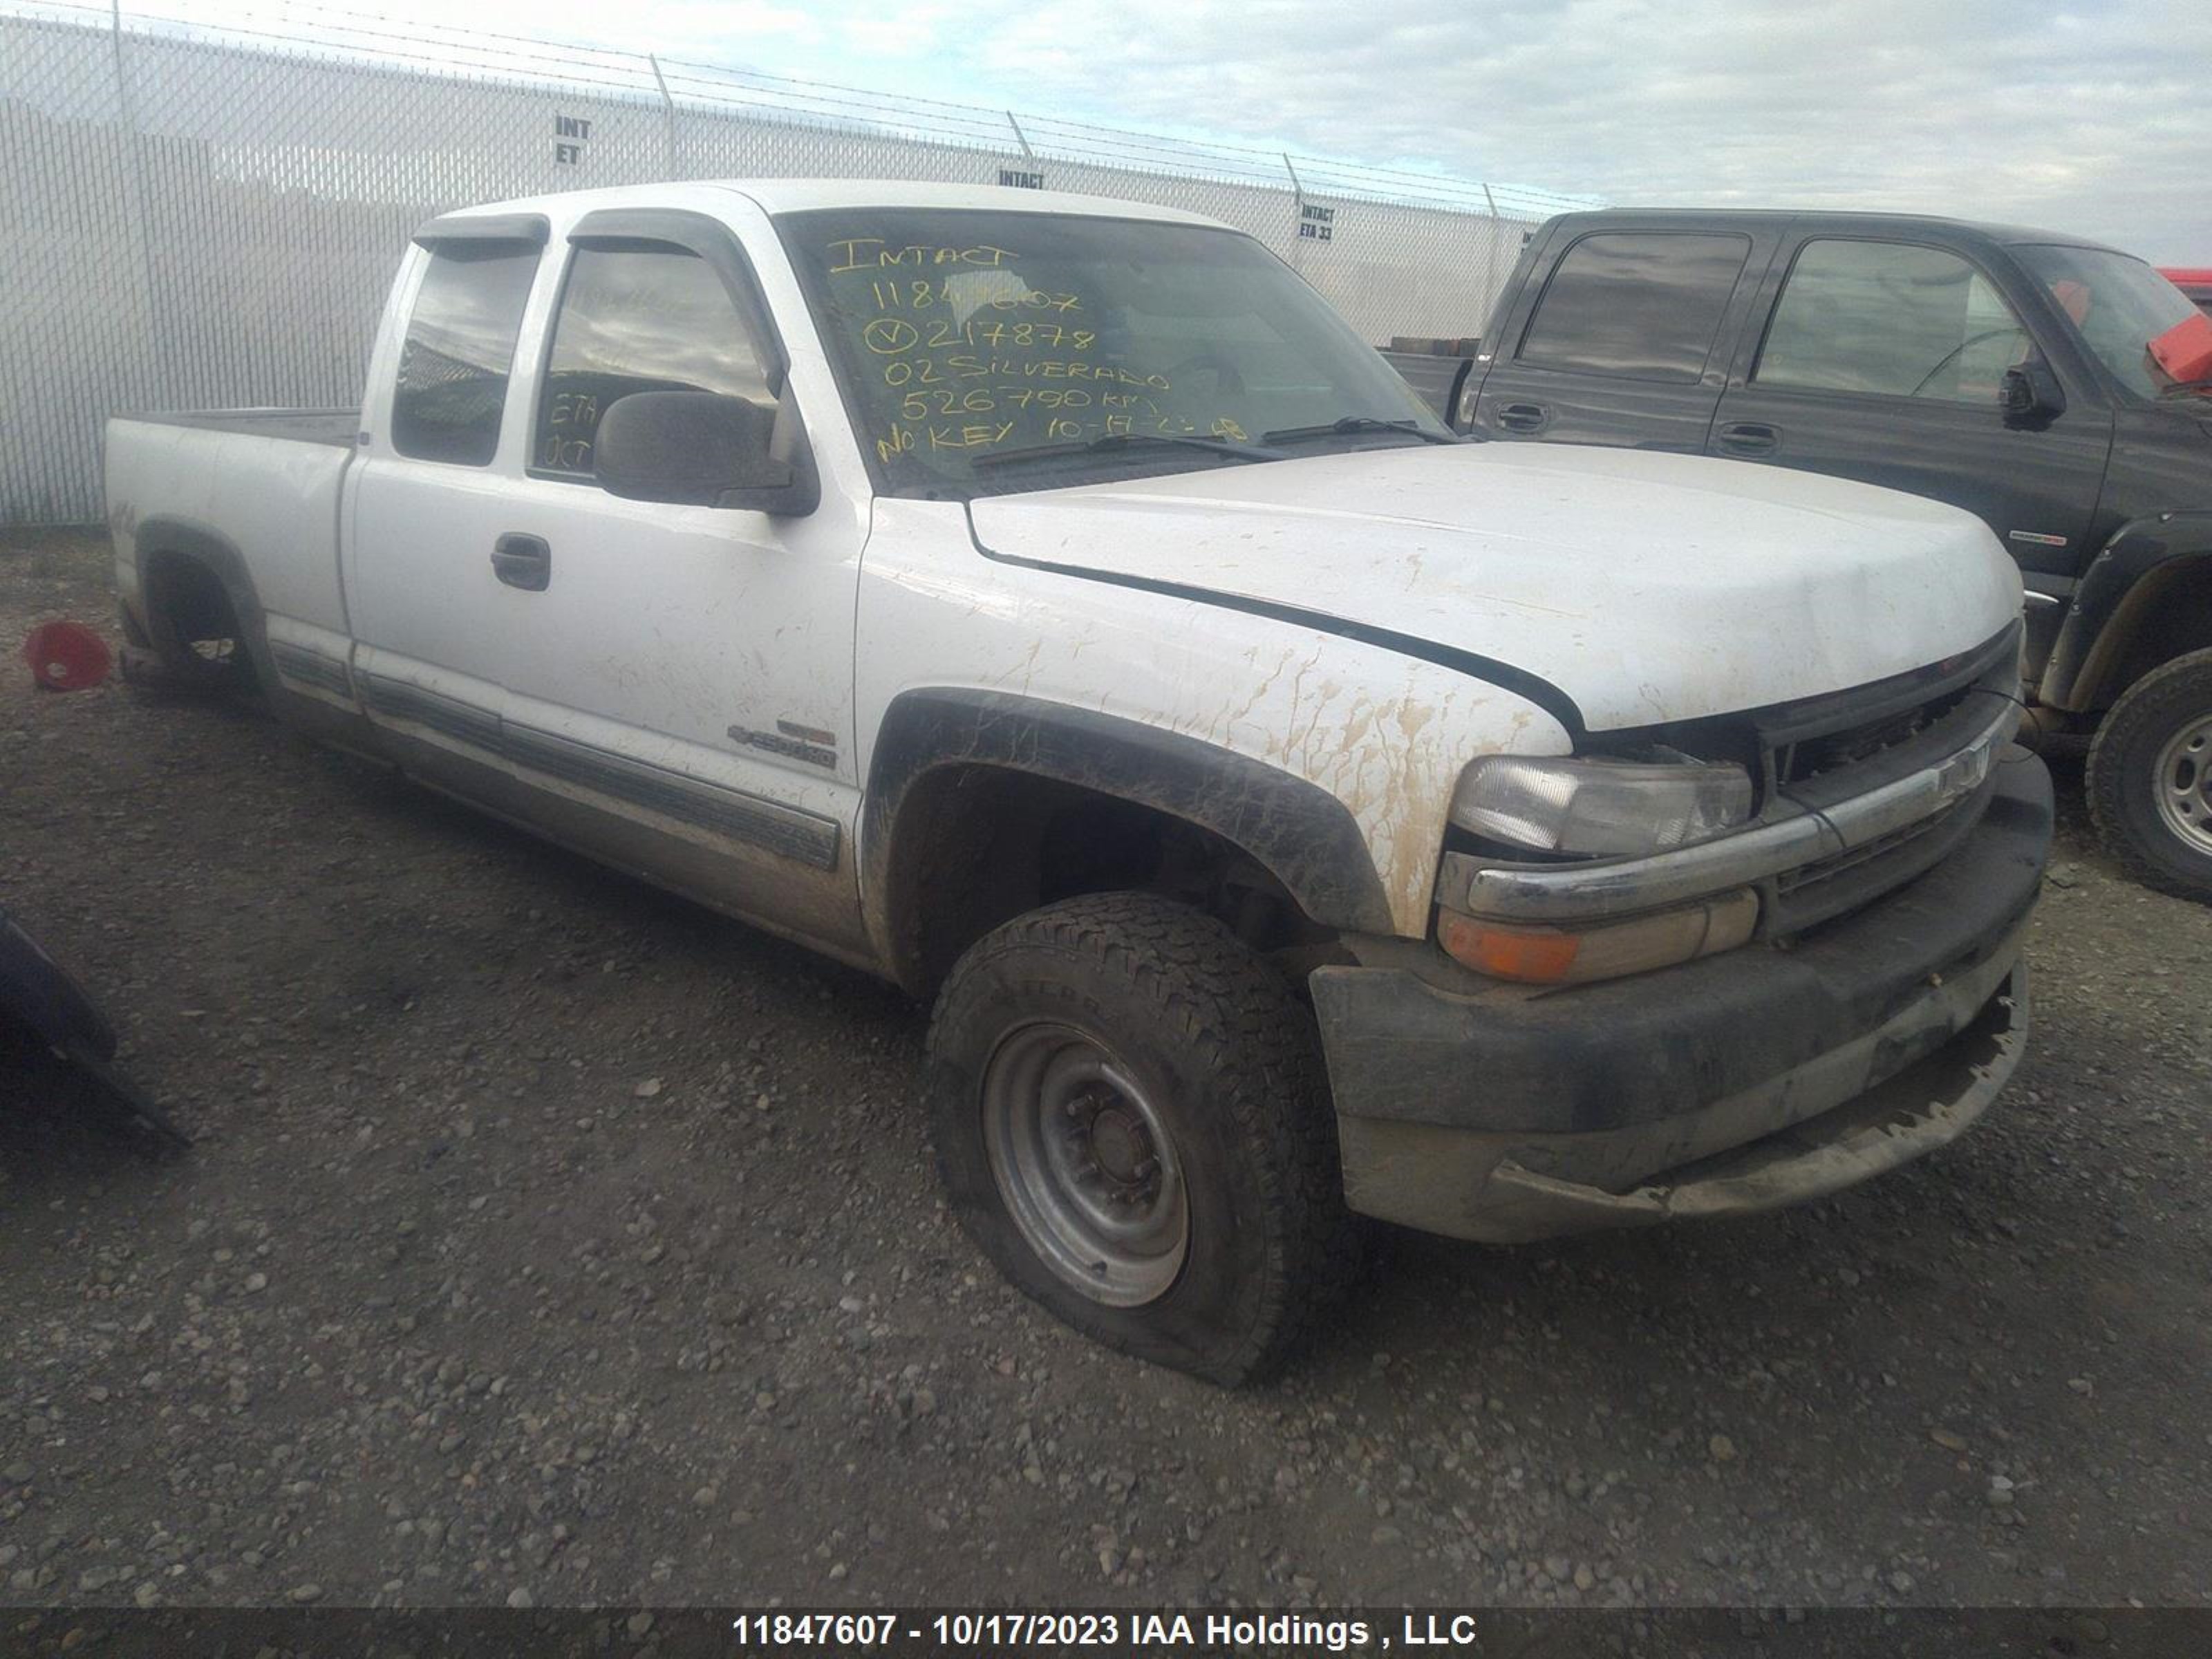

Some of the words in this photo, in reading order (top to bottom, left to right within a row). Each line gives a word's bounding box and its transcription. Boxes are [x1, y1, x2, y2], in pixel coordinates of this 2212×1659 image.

[556, 115, 591, 140] INT
[556, 143, 580, 165] ET
[999, 170, 1044, 190] INTACT
[1302, 203, 1335, 223] INTACT
[1300, 223, 1316, 238] ETA
[827, 238, 1020, 272] INTACT
[926, 321, 1096, 350] 217878
[885, 359, 945, 385] 02
[929, 421, 1013, 451] KEY
